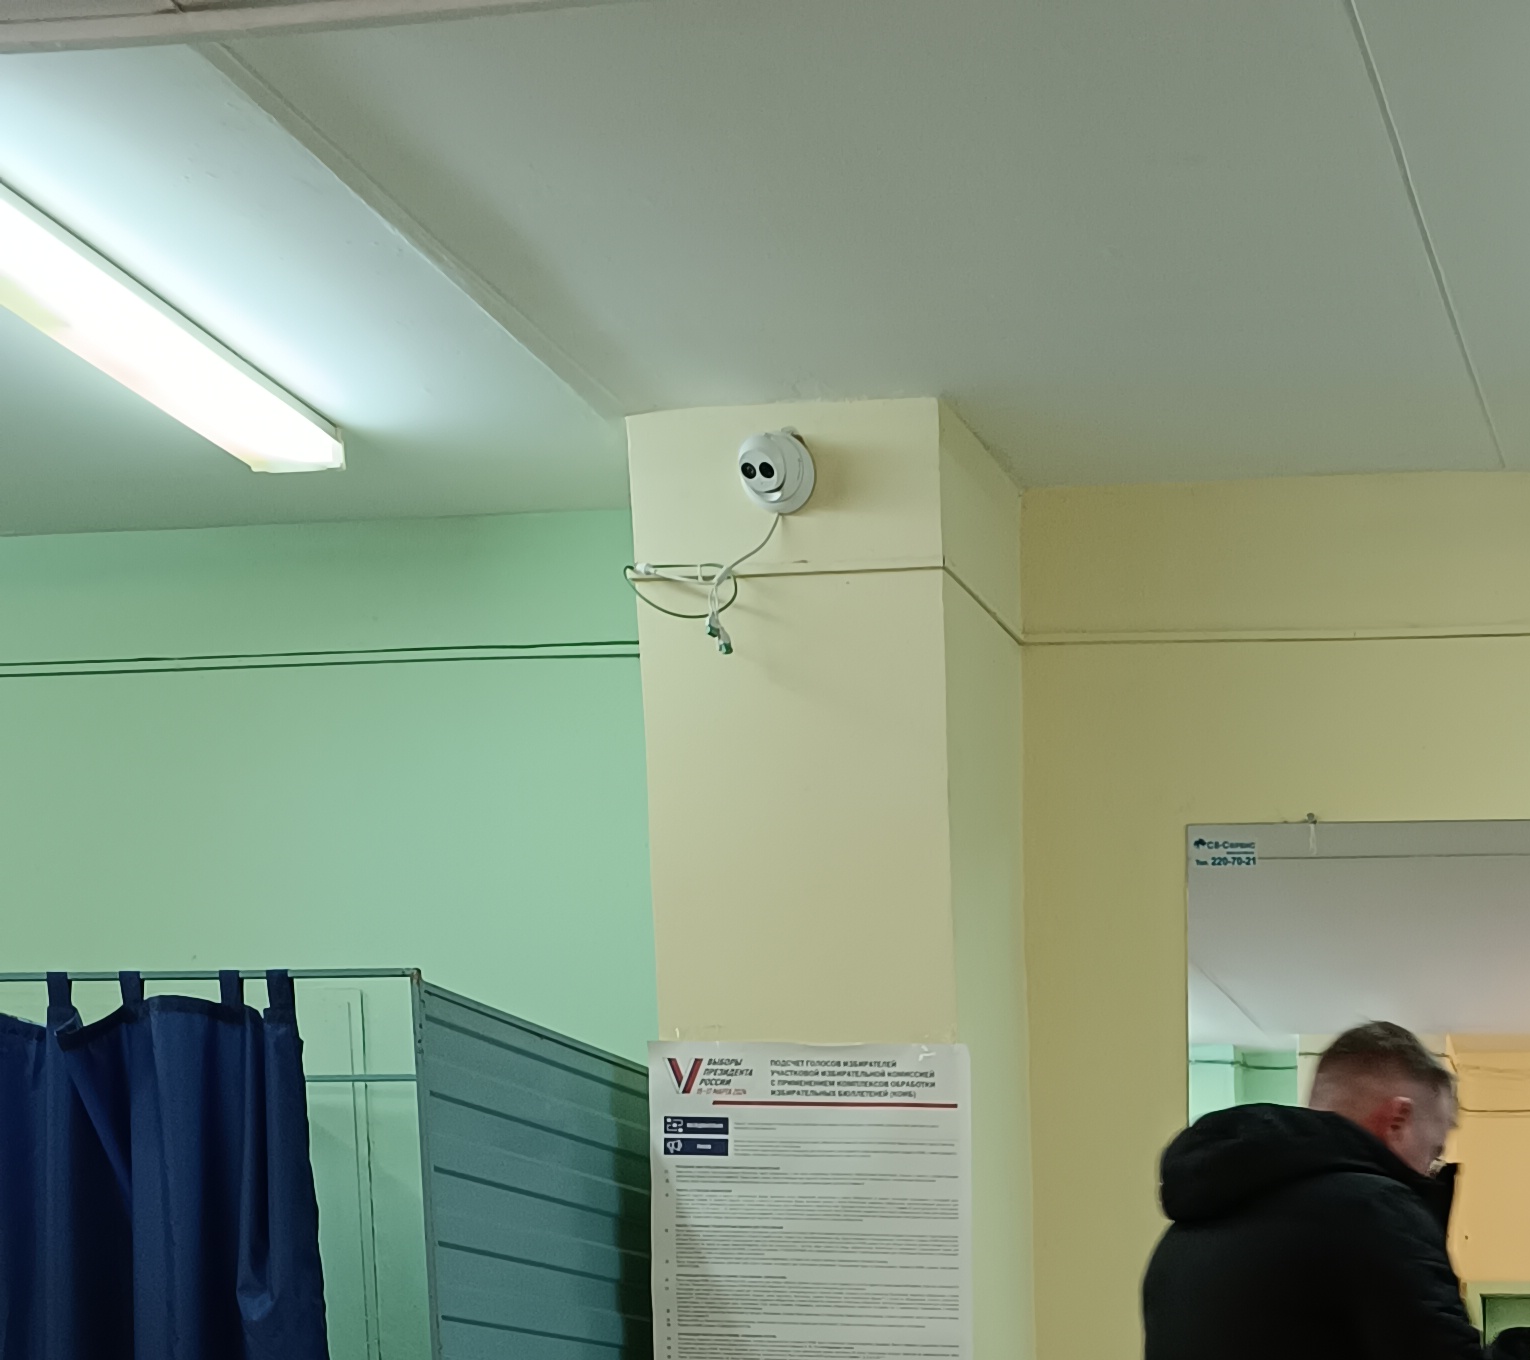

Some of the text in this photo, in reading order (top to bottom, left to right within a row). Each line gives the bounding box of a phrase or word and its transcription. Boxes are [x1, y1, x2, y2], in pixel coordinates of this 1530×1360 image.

[1211, 857, 1256, 866] 220-70-21
[707, 1058, 743, 1066] ВЫБОРЫ
[770, 1059, 897, 1068] ПОДСЧЕТ ГОЛОСОВ ИЗБИРАТЕЛЕЙ
[703, 1068, 753, 1076] ПРЕЗИДЕНТА
[770, 1069, 935, 1078] УЧАСТКОВОЙ ИЗБИРАТЕЛЬНОЙ КОМИССИЕЙ
[699, 1078, 732, 1086] РОССИИ
[838, 1089, 888, 1098] БЮЛЛЕТЕНЕЙ
